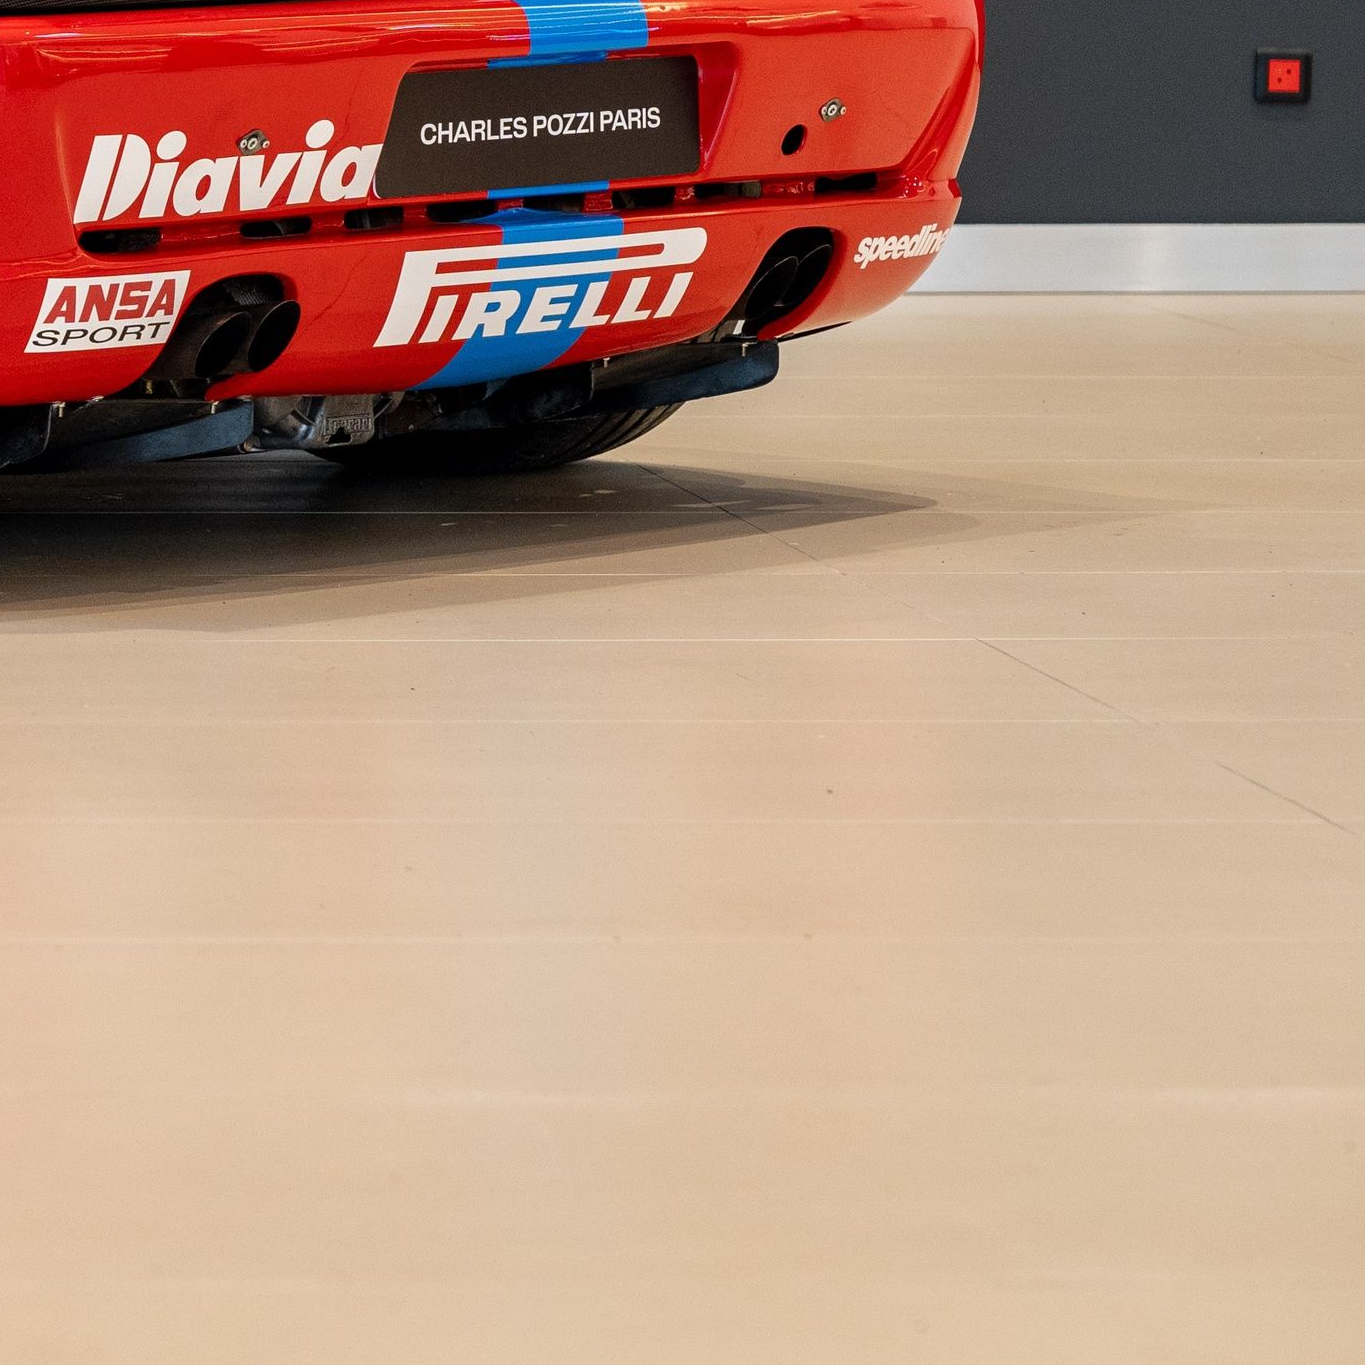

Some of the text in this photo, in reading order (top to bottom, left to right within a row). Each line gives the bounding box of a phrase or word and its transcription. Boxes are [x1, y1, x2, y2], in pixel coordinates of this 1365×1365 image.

[420, 106, 662, 146] CHARLES POZZI PARIS
[72, 118, 385, 225] Diavia
[42, 278, 177, 325] ANSA
[372, 226, 708, 348] PIRELLI
[31, 321, 171, 347] SPORT
